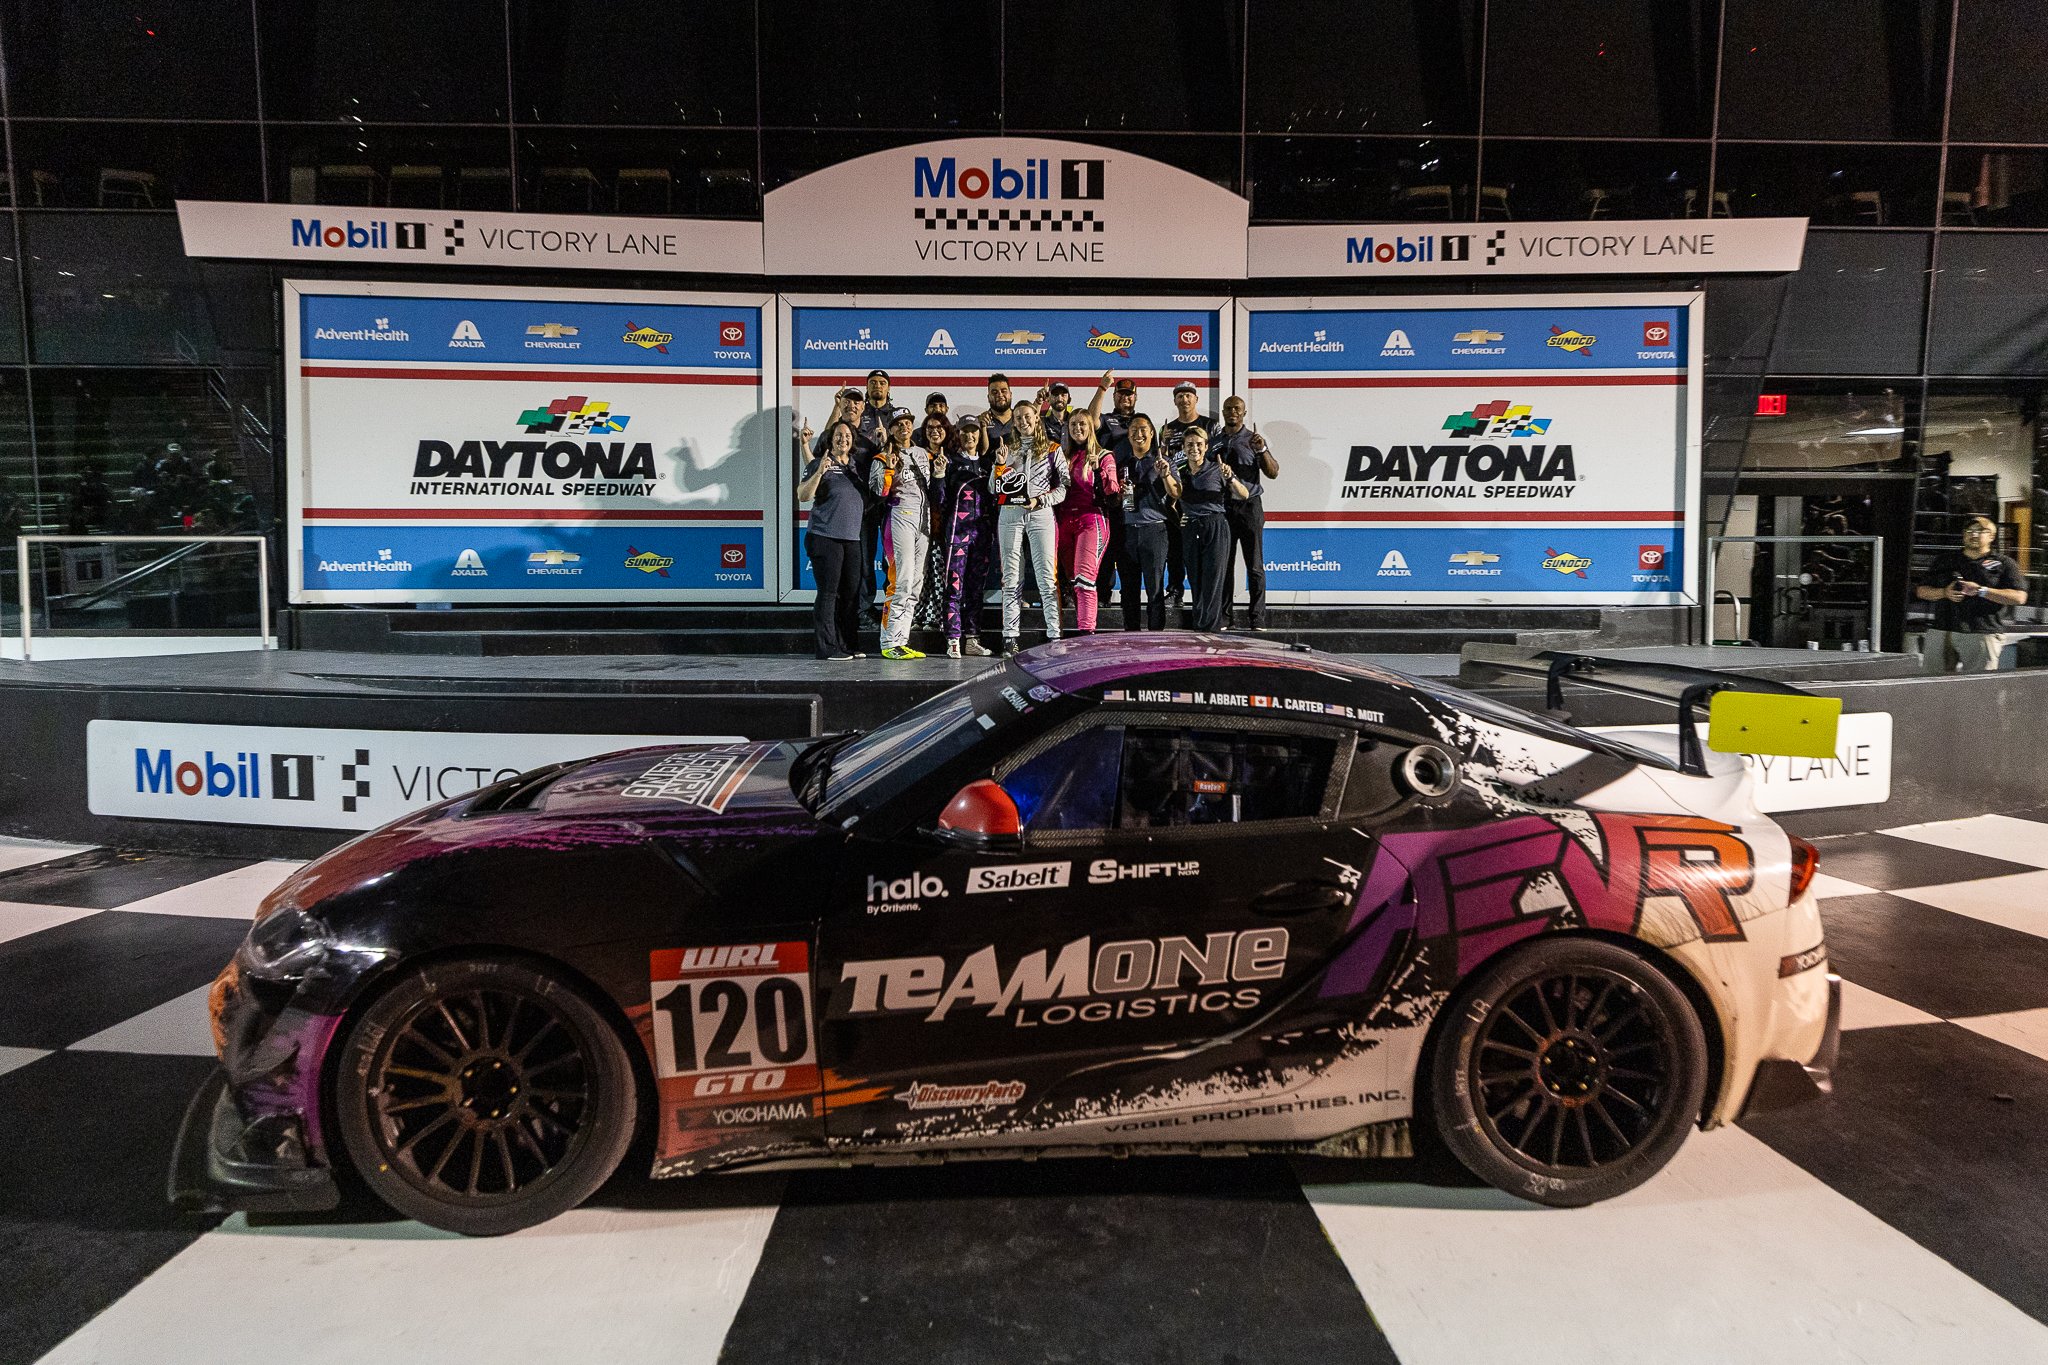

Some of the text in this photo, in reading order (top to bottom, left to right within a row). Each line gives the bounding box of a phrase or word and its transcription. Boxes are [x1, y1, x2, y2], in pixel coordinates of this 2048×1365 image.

[914, 157, 1049, 199] Mobil
[291, 218, 388, 249] Mobil
[479, 227, 598, 254] VICTORY
[606, 233, 678, 256] LANE
[915, 240, 1104, 263] VICTORY LANE
[1346, 236, 1434, 264] Mobil
[1519, 235, 1636, 258] VICTORY
[1643, 234, 1715, 256] LANE
[315, 328, 409, 342] AdventHealth
[625, 333, 672, 343] SUNOCO
[1548, 336, 1596, 347] SUNOCO
[448, 340, 486, 348] AXALTA
[524, 341, 582, 349] CHEVROLET
[804, 339, 889, 351] AdventHealth
[1088, 338, 1133, 348] SUNOCO
[1259, 341, 1344, 353] AdventHealth
[713, 351, 752, 360] TOYOTA
[924, 348, 959, 356] AXALTA
[1380, 349, 1416, 357] AXALTA
[1451, 347, 1507, 355] CHEVROLET
[1636, 351, 1676, 360] TOYOTA
[1172, 354, 1209, 363] TOYOTA
[413, 439, 658, 480] DAYTONA
[1344, 444, 1577, 483] DAYTONA
[410, 481, 657, 497] INTERNATIONAL SPEEDWAY
[1340, 485, 1577, 499] INTERNATIONAL SPEEDWAY
[318, 560, 412, 572] AdventHealth
[625, 557, 673, 567] SUNOCO
[1544, 559, 1590, 569] SUNOCO
[451, 569, 489, 577] AXALTA
[714, 573, 752, 582] TOYOTA
[1376, 569, 1412, 577] AXALTA
[1631, 574, 1671, 583] TOYOTA
[1125, 690, 1171, 703] L. HAYES
[1194, 692, 1249, 707] M. ABBATE
[1271, 697, 1324, 714] A. CARTER
[1345, 707, 1385, 724] S. MOTT
[1789, 745, 1870, 782] LANE
[135, 747, 260, 799] Mobil
[1177, 861, 1200, 870] UP
[977, 865, 1060, 890] Sabelt
[866, 870, 950, 903] halo.
[867, 905, 880, 916] By
[680, 943, 780, 971] WRL
[1014, 987, 1262, 1028] LOGISTICS
[655, 976, 809, 1073] 120
[693, 1069, 787, 1097] GTO
[712, 1102, 807, 1125] YOKOHAMA
[1103, 1116, 1188, 1133] VOGEL
[1358, 1088, 1407, 1104] INC.
